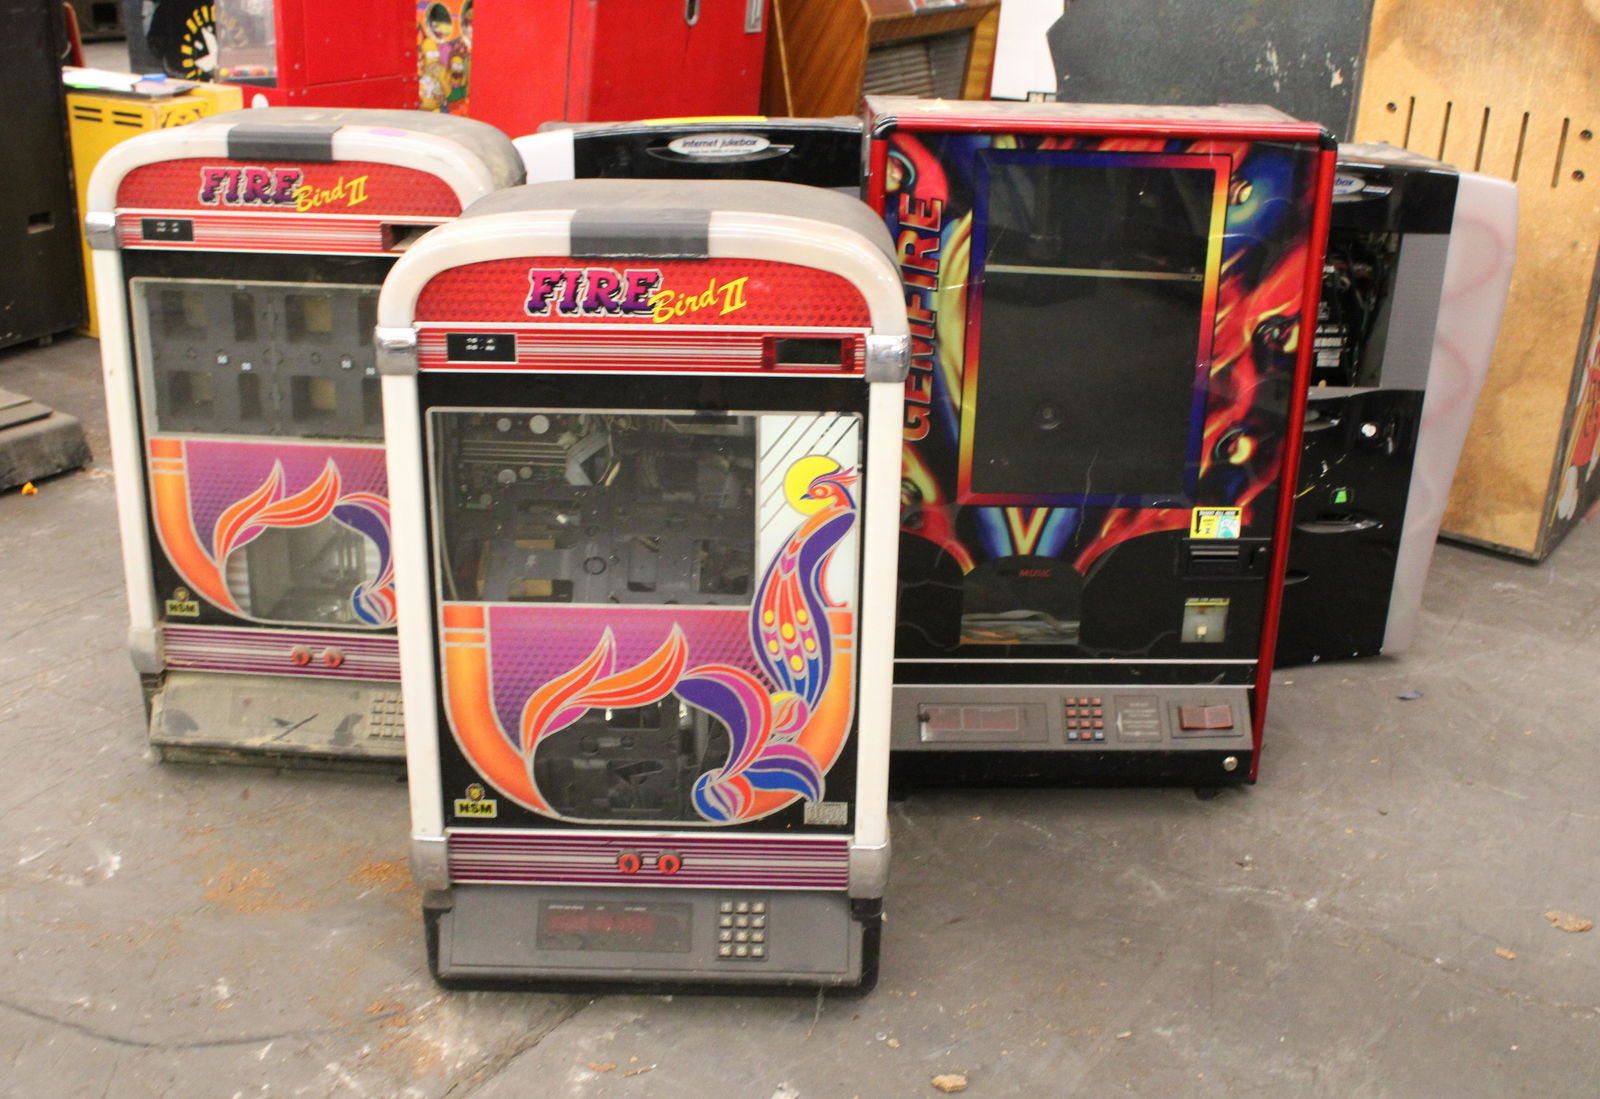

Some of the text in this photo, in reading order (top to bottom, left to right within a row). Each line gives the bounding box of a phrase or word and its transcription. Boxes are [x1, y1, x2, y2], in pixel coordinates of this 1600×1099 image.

[682, 138, 758, 149] internet jukebox
[199, 167, 369, 212] FIRE Bird II
[524, 267, 749, 323] FIRE Bird II
